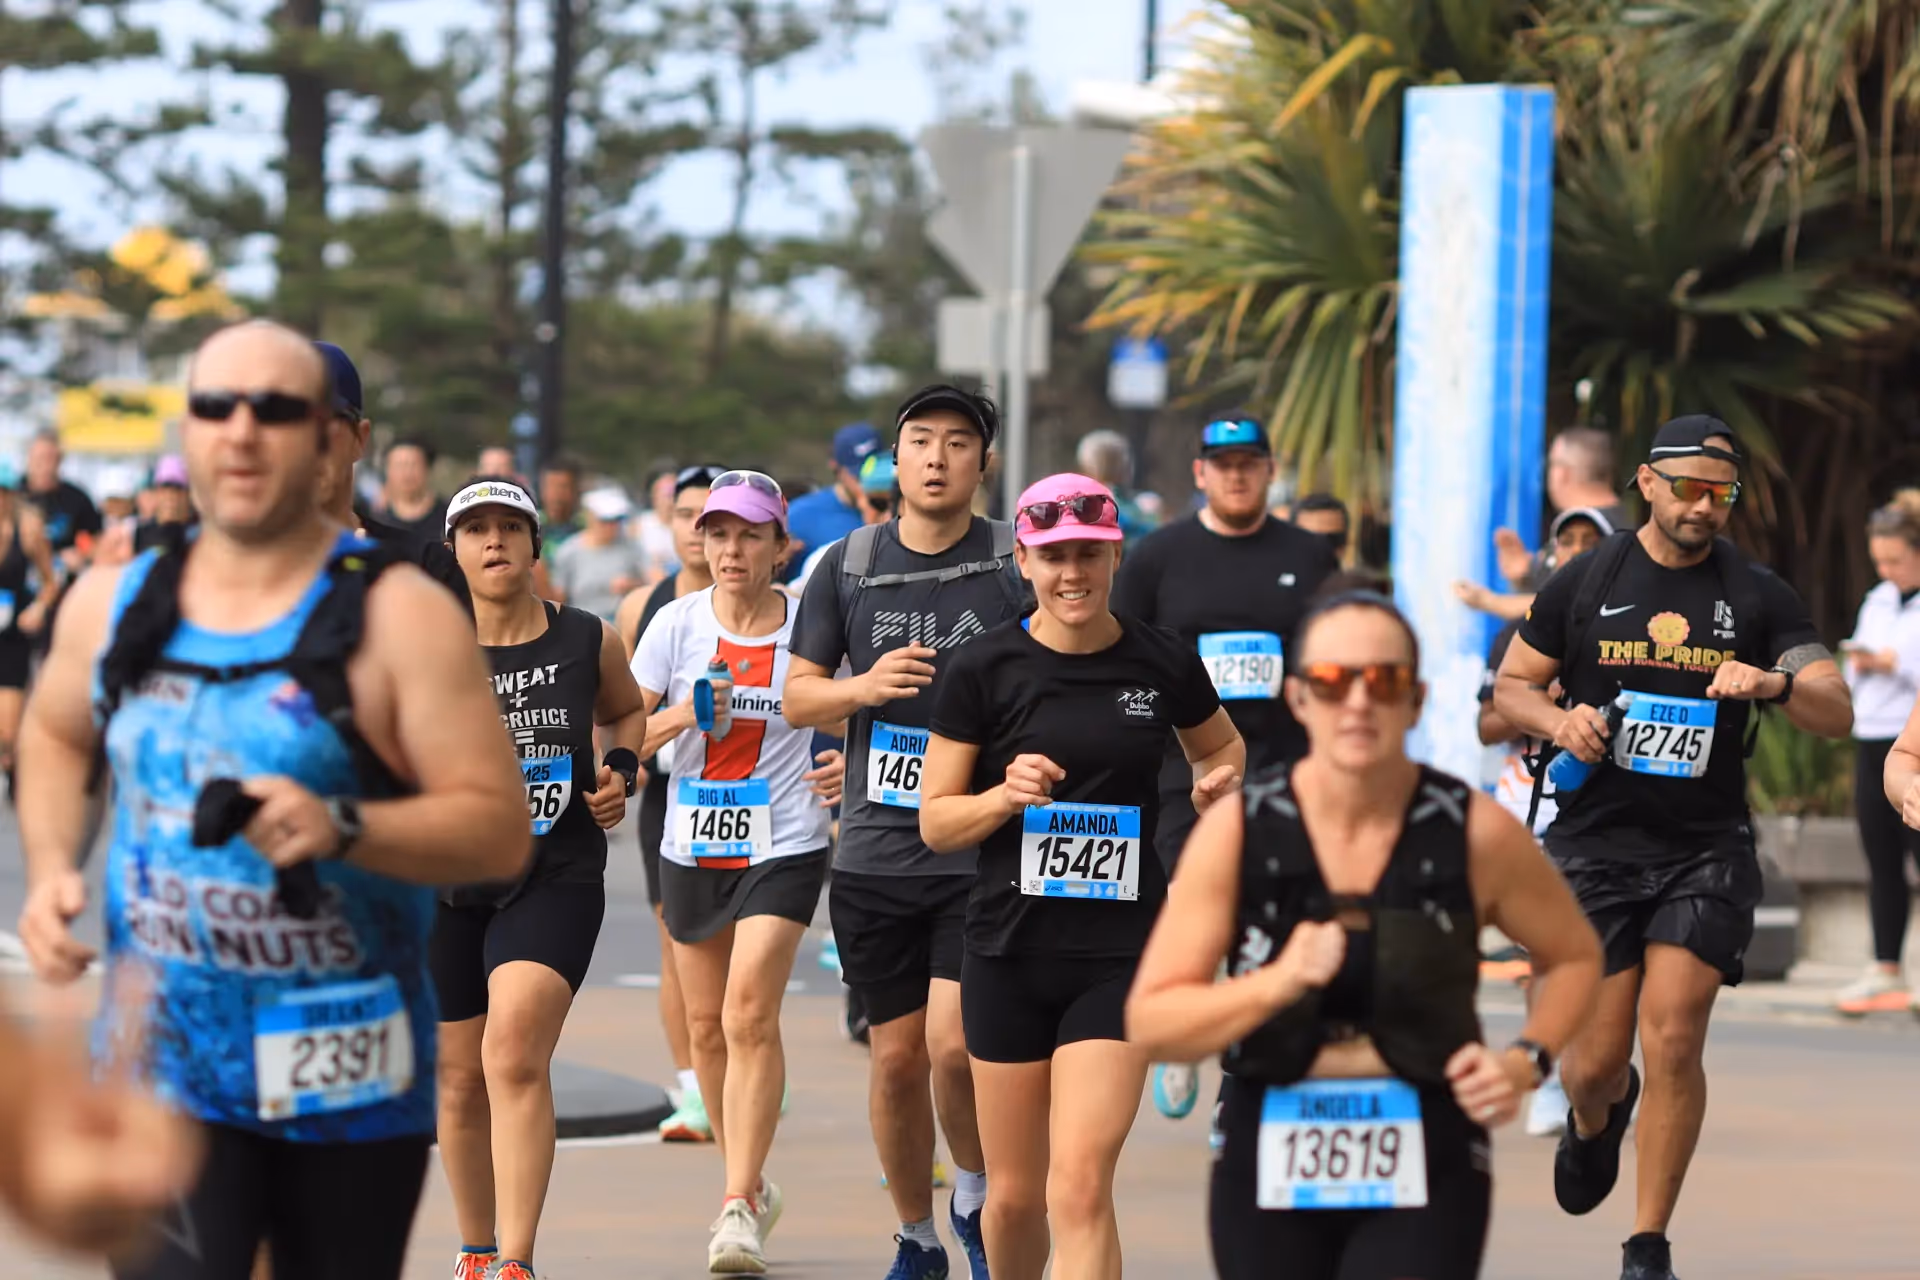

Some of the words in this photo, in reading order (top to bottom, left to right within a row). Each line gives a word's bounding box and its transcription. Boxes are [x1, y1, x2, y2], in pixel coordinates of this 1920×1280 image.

[460, 485, 522, 504] spotters
[872, 609, 986, 649] FILA
[1213, 656, 1274, 684] 12190
[1598, 640, 1649, 660] THE
[1655, 643, 1736, 668] PRIDE
[486, 663, 559, 695] WEAT
[1650, 703, 1677, 723] EZE
[1626, 722, 1706, 761] 12745
[877, 753, 922, 791] 146
[525, 783, 563, 819] 56
[697, 788, 719, 805] BIG
[722, 789, 740, 806] AL
[689, 808, 752, 841] 1466
[1048, 811, 1119, 836] AMANDA
[1036, 836, 1129, 881] 15421
[211, 920, 358, 970] NUTS
[288, 1022, 391, 1089] 2391
[1284, 1126, 1402, 1180] 13619
